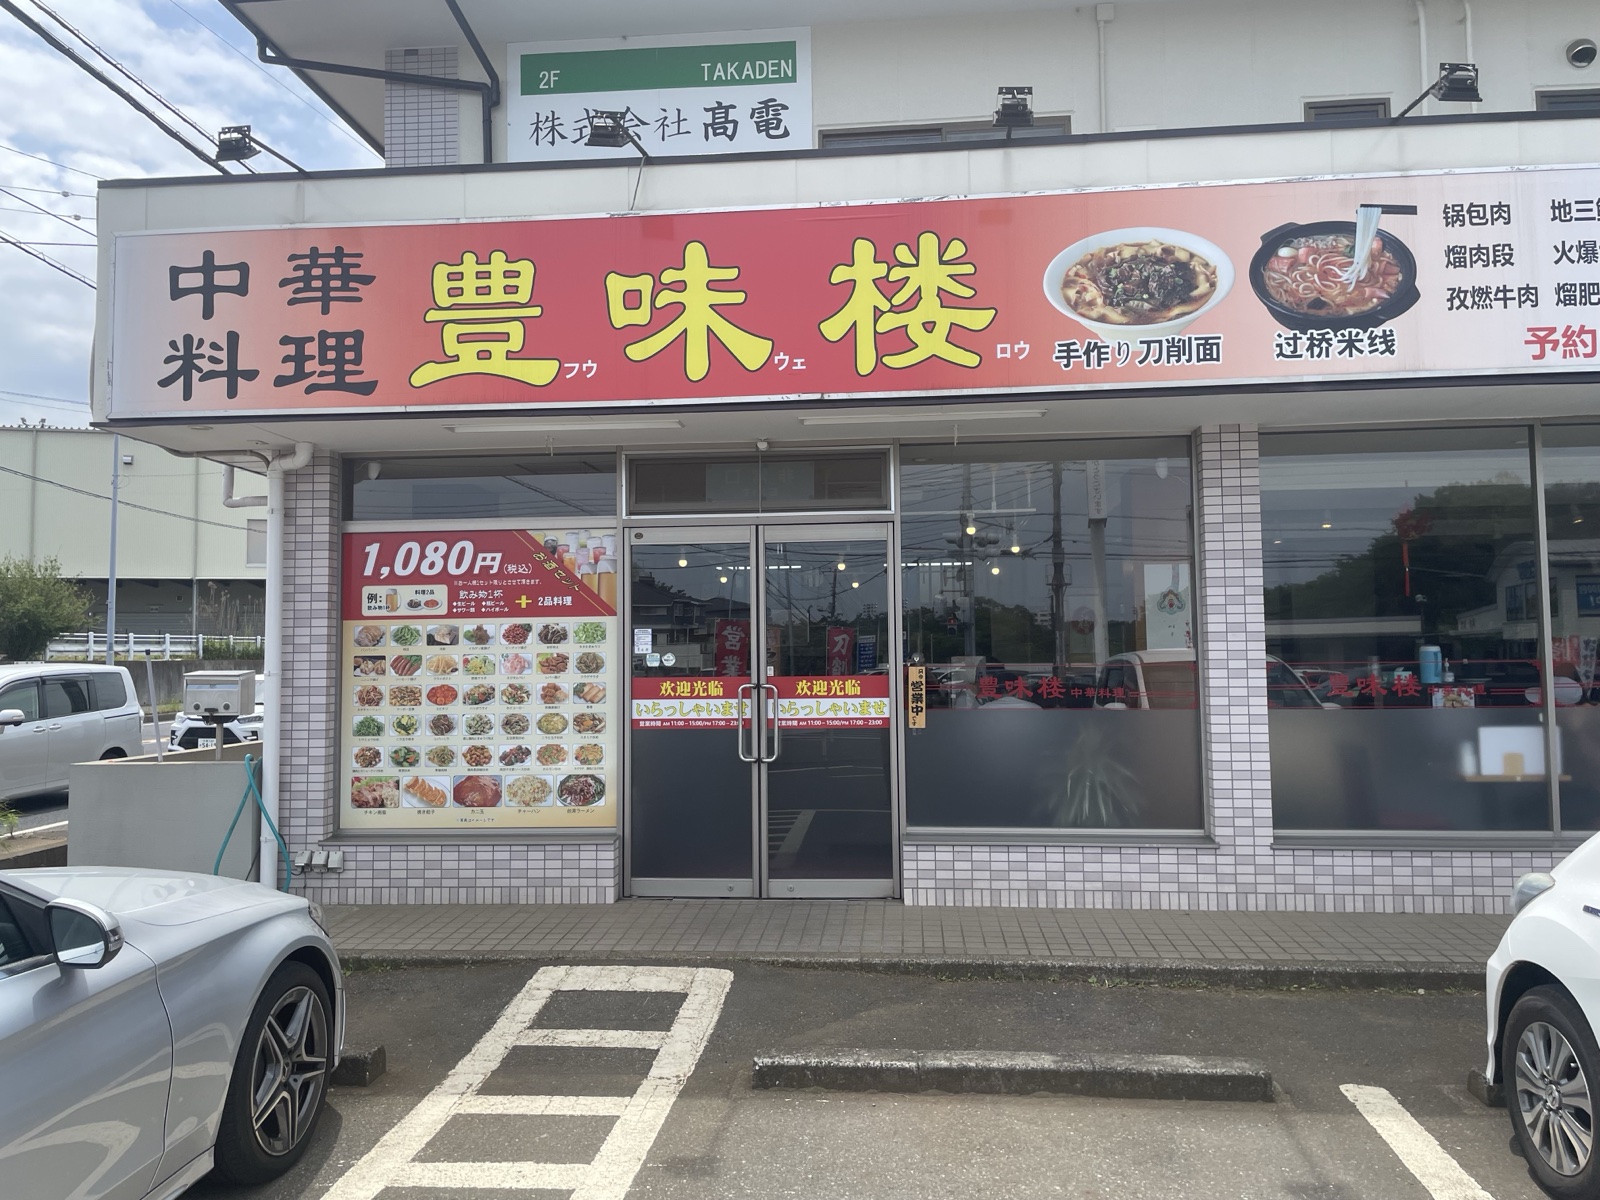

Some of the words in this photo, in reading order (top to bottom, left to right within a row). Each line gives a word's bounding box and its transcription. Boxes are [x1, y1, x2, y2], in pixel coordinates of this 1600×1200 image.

[539, 70, 560, 89] 2F
[701, 59, 793, 81] TAKADEN
[1443, 201, 1511, 227] 锅包肉
[1550, 198, 1600, 222] 地三
[1444, 243, 1515, 269] 熘肉段
[169, 246, 377, 321] 中華
[1446, 283, 1539, 312] 孜燃牛肉
[996, 341, 1031, 360] ロウ
[1054, 334, 1222, 369] 手作り刀削面
[1275, 329, 1397, 360] 过桥米线
[1524, 324, 1598, 361] 予約
[157, 330, 379, 402] 料理
[564, 362, 597, 379] フウ
[362, 540, 503, 580] 1,080円
[459, 589, 504, 599] 飲み物1杯
[537, 596, 573, 606] 2品料理
[659, 680, 723, 697] 欢迎光临
[795, 679, 861, 696] 欢迎光临
[976, 675, 1066, 698] 豊味楼
[635, 701, 749, 717] いらっしゃいませ
